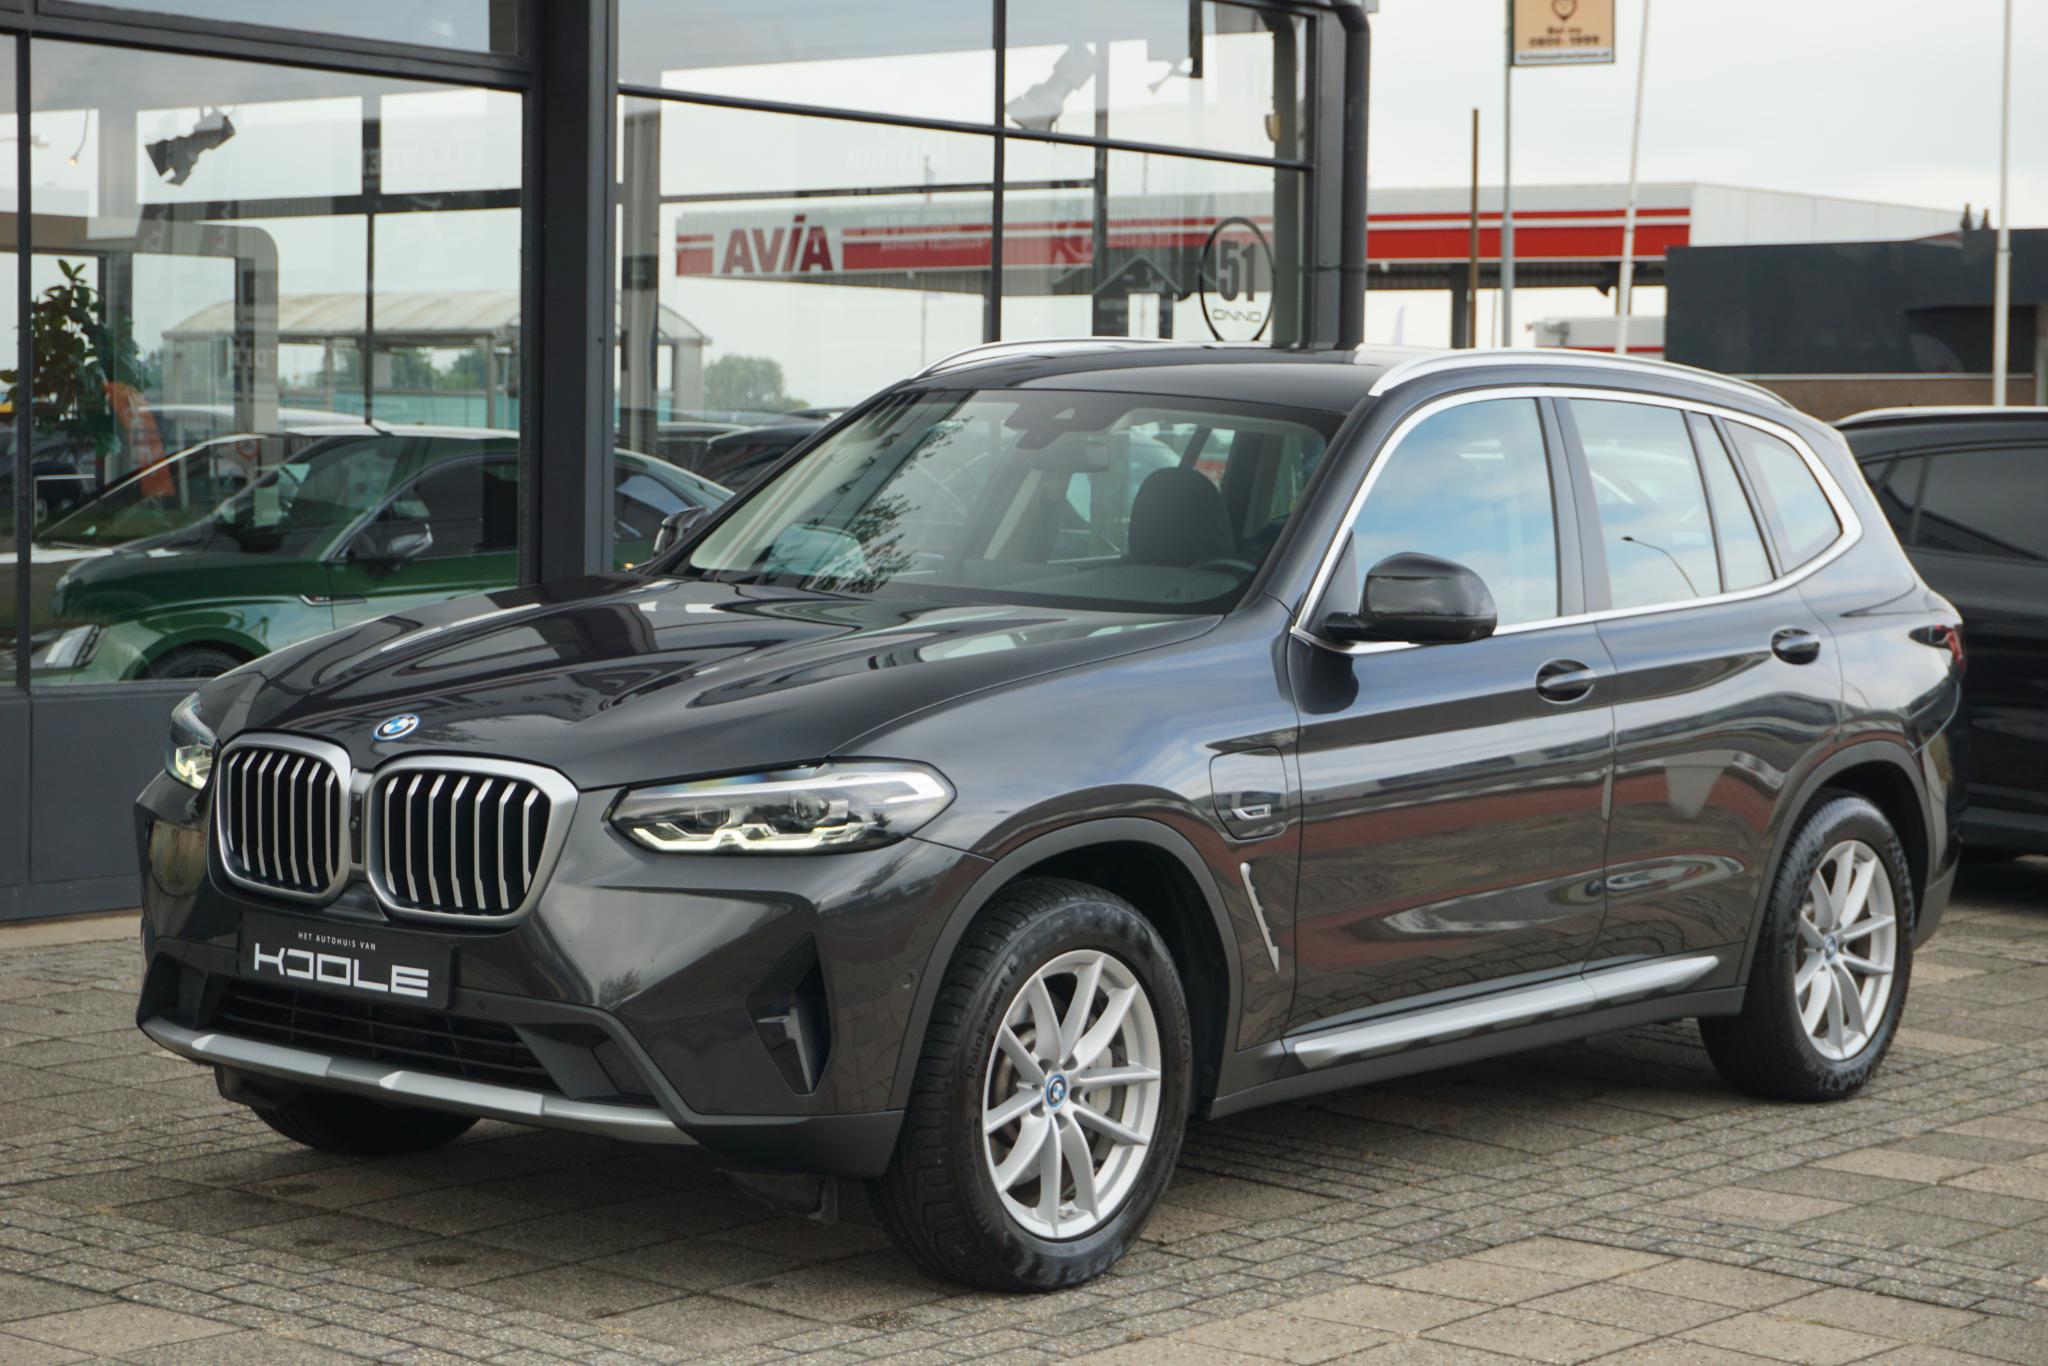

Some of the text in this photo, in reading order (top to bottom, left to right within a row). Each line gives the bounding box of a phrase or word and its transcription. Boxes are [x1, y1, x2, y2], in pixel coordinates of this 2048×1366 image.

[722, 214, 833, 274] AVIA
[1220, 239, 1256, 302] 51
[298, 931, 377, 951] HET AUTOHUIS VAN
